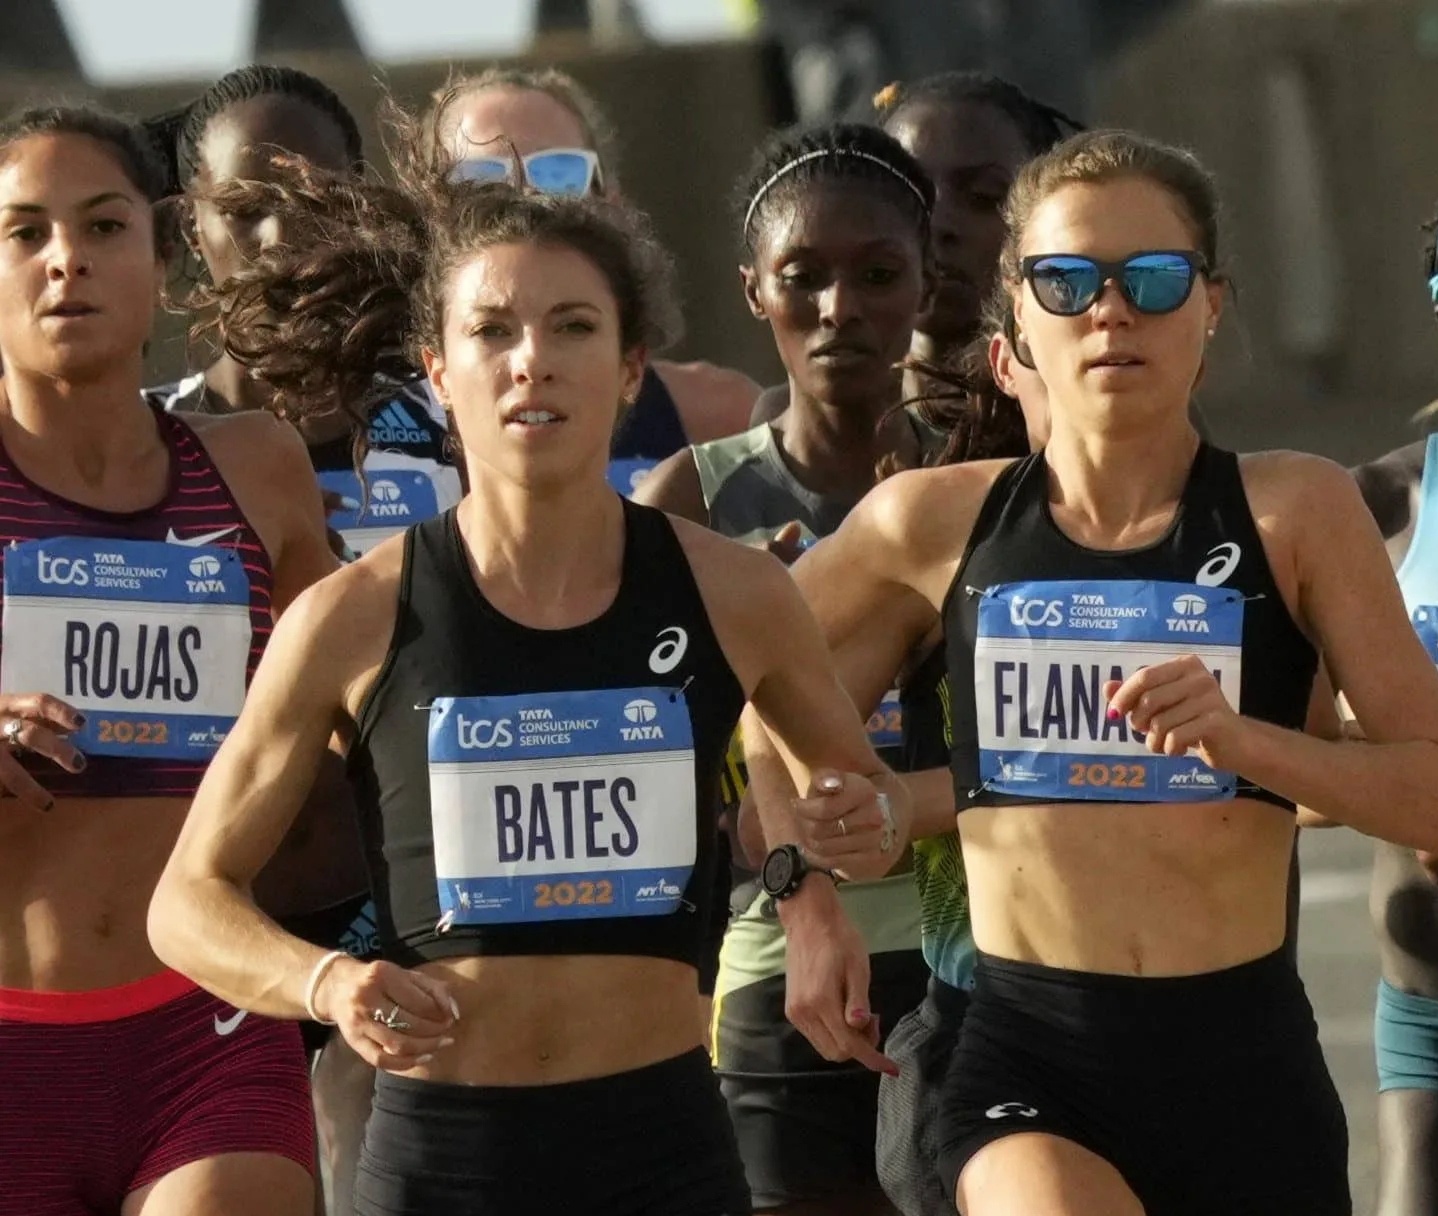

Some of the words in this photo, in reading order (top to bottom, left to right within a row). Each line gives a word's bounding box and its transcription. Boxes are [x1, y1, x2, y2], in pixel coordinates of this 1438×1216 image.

[370, 504, 411, 517] TATA
[94, 553, 125, 564] TATA
[37, 550, 89, 586] tcs
[94, 564, 168, 579] CONSULTANCY
[94, 576, 141, 589] SERVICES
[185, 580, 226, 593] TATA
[1071, 594, 1105, 606] TATA
[1009, 595, 1064, 627] tcs
[1070, 606, 1147, 619] CONSULTANCY
[1068, 618, 1118, 629] SERVICES
[1166, 618, 1210, 633] TATA
[64, 620, 201, 702] ROJAS
[994, 661, 1222, 744] FLANA
[518, 709, 553, 720] TATA
[97, 719, 169, 745] 2022
[457, 713, 513, 748] tcs
[518, 719, 599, 733] CONSULTANCY
[620, 726, 664, 741] TATA
[519, 733, 571, 746] SERVICES
[1067, 763, 1147, 788] 2022
[494, 777, 639, 863] BATES
[534, 880, 614, 908] 2022
